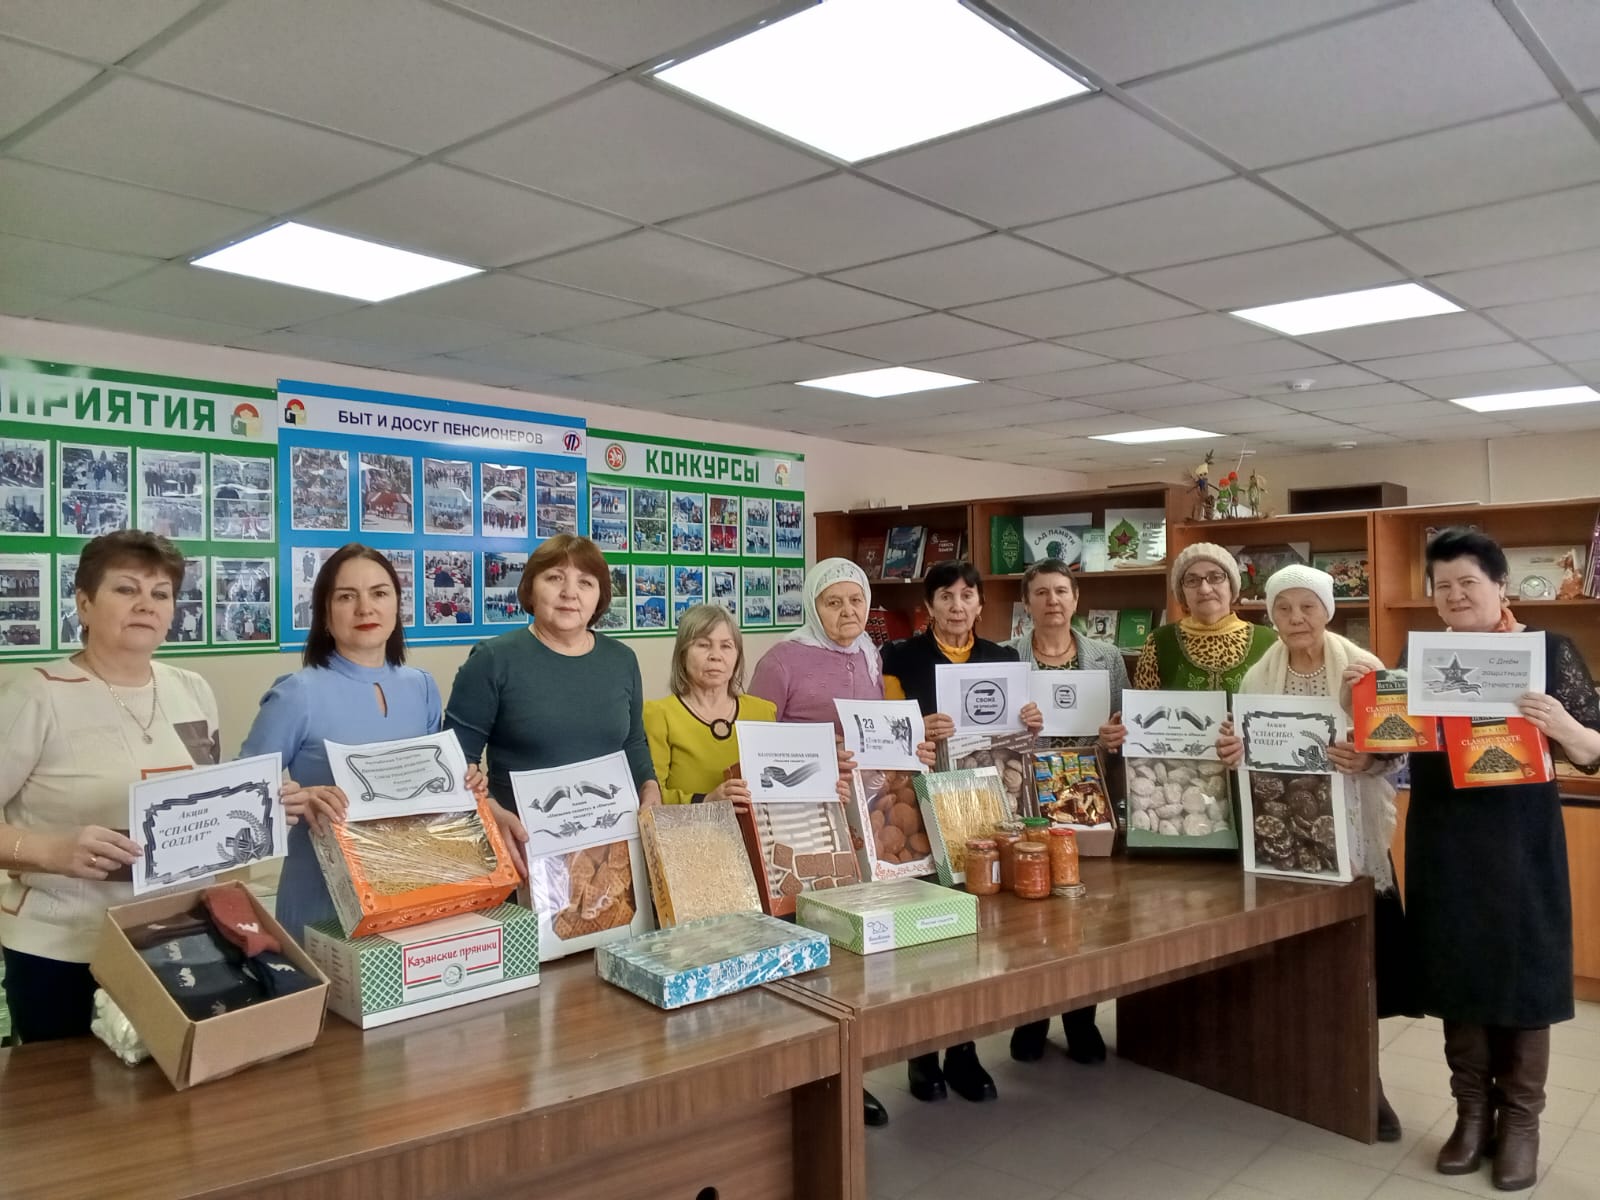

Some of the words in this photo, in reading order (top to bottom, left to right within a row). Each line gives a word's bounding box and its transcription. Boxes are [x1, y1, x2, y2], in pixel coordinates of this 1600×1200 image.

[338, 410, 373, 426] БЫТ
[377, 414, 388, 428] И
[391, 416, 440, 433] ДОСУГ
[443, 422, 544, 445] ПЕНСИОНЕРОВ
[646, 448, 760, 483] КОНКУРСЫ
[1034, 532, 1048, 546] САД
[1048, 529, 1076, 546] ПАМЯТИ
[862, 718, 875, 729] 23
[179, 807, 209, 820] Акция
[407, 950, 458, 968] Казанские
[459, 942, 497, 961] пряники
